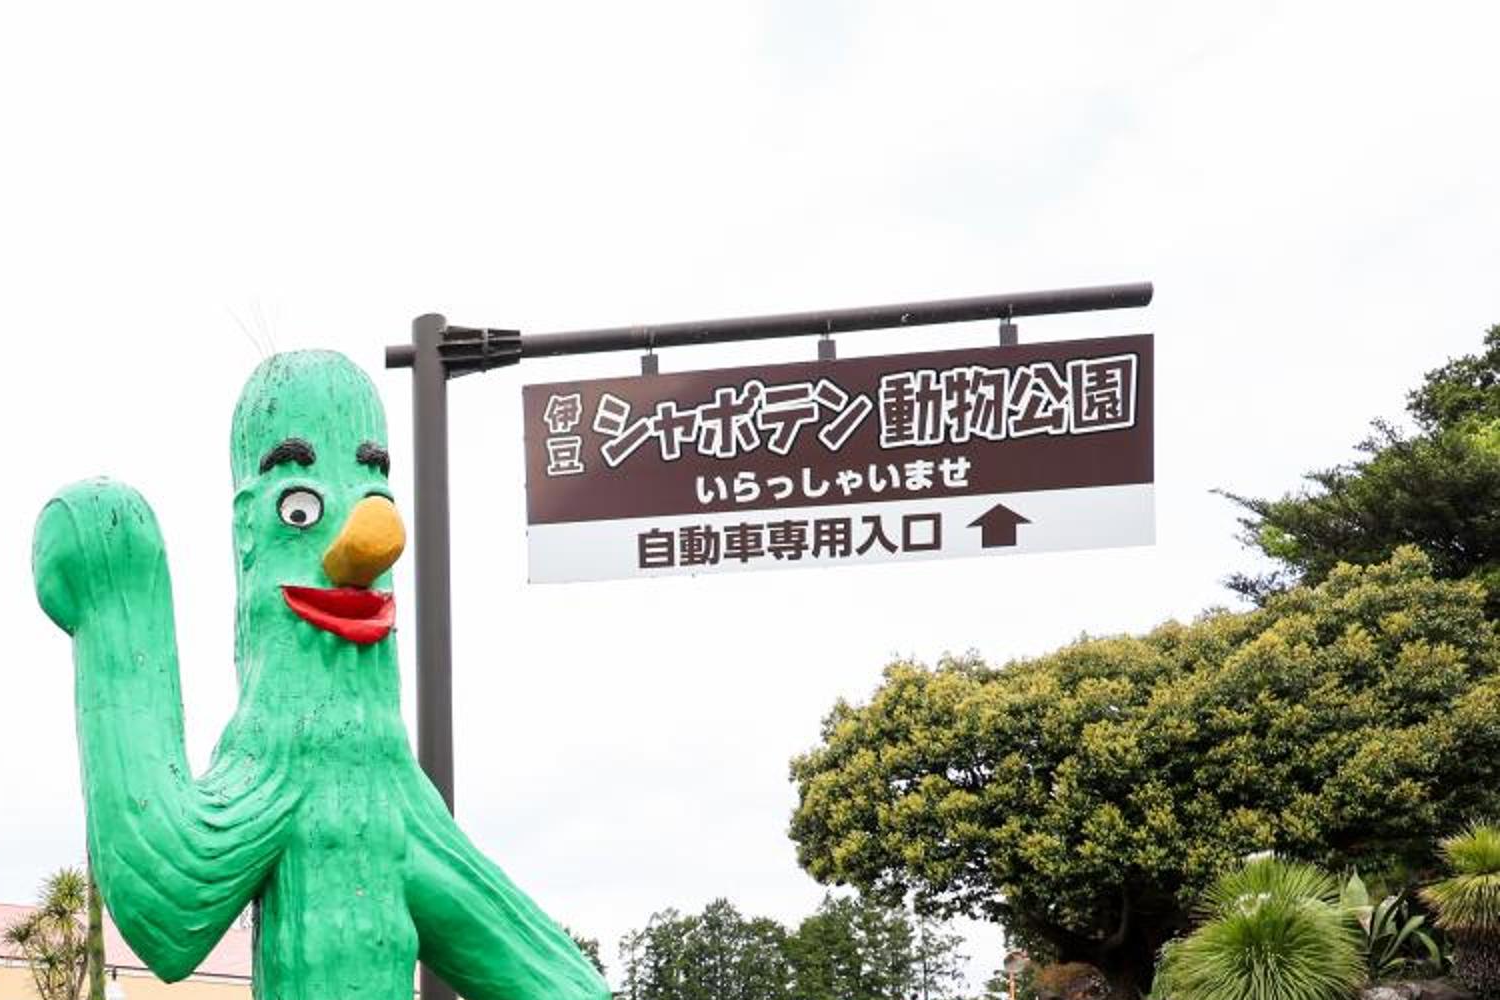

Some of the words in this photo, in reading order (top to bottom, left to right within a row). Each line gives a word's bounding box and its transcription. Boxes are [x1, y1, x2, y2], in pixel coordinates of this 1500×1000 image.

[543, 393, 584, 475] 伊豆
[695, 456, 972, 504] いらっしゃいませ
[637, 512, 942, 569] 自動車専用入口
